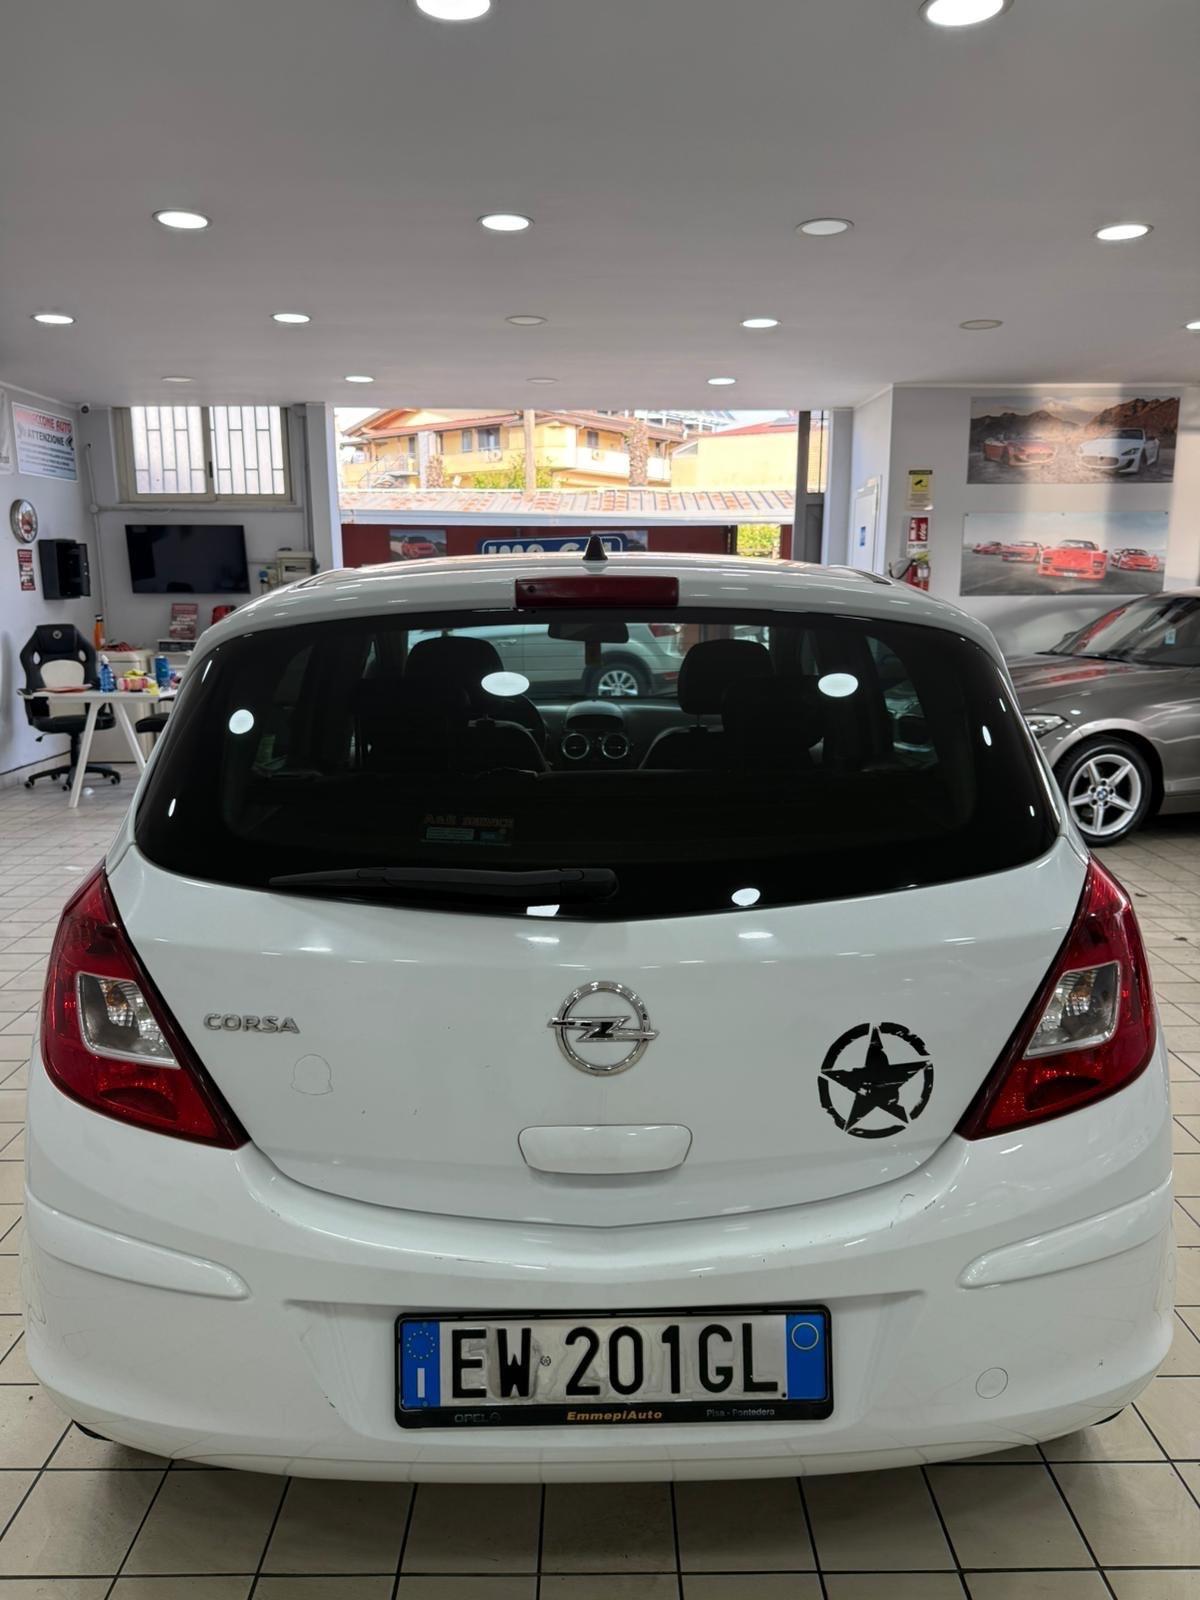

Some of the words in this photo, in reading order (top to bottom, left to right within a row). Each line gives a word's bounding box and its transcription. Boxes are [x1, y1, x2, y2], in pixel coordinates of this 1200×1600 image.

[203, 1013, 300, 1034] CORSA
[452, 1328, 531, 1398] EW
[565, 1323, 778, 1396] 201GL
[417, 1367, 426, 1398] I
[732, 1407, 776, 1418] Pontedera
